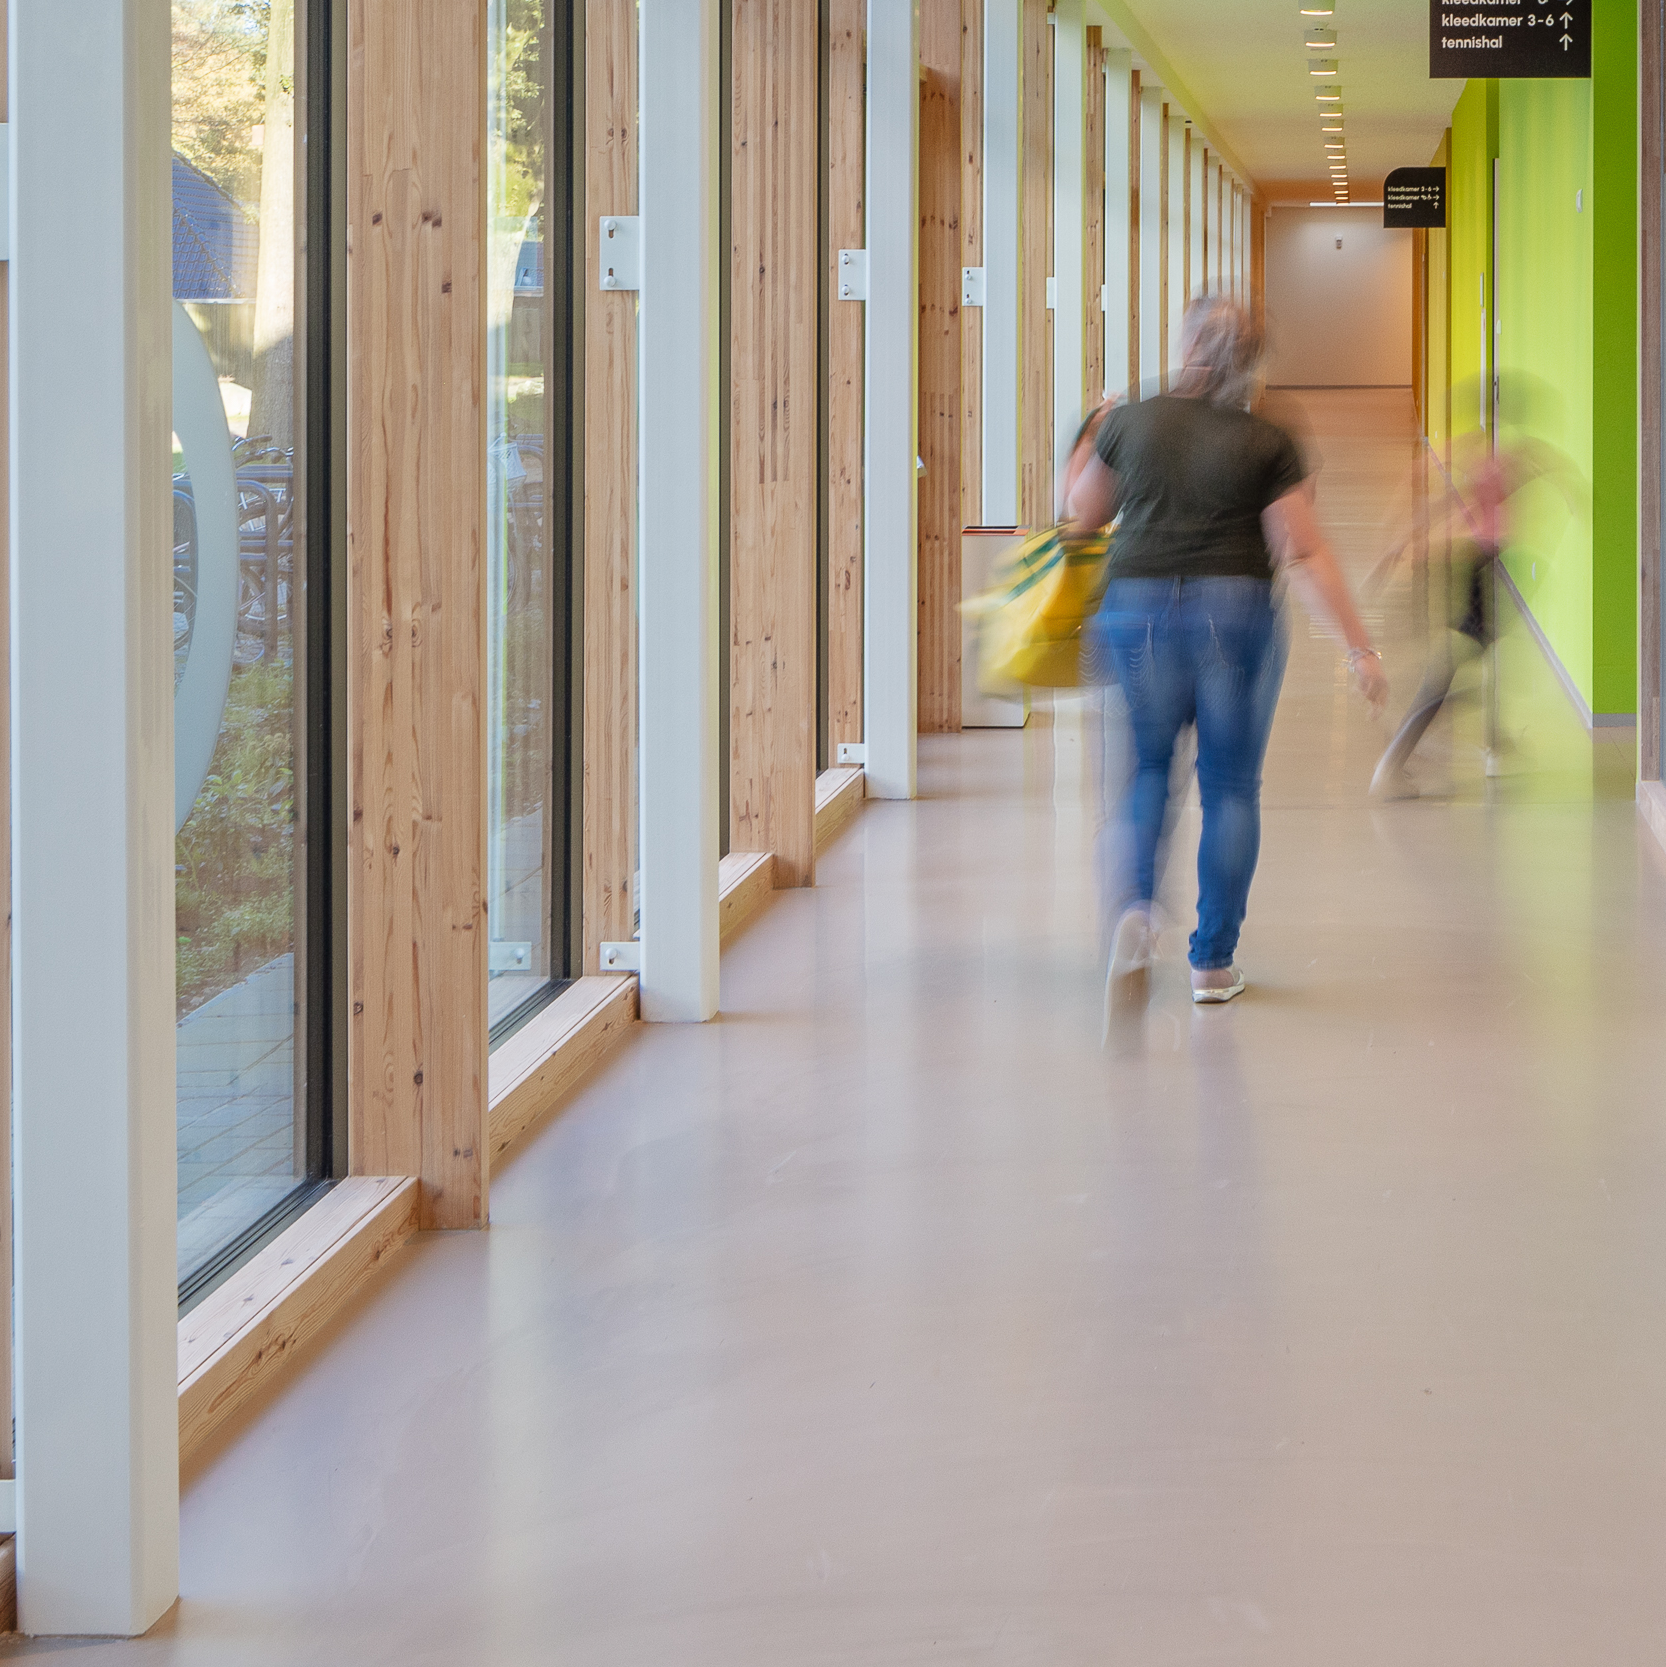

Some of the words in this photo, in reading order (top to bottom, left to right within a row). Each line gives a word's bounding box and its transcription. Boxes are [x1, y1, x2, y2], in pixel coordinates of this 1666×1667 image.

[1441, 13, 1524, 27] kleedkamer
[1527, 13, 1555, 27] 3-6
[1441, 34, 1503, 49] tennishal
[1387, 185, 1420, 193] kleedkamer
